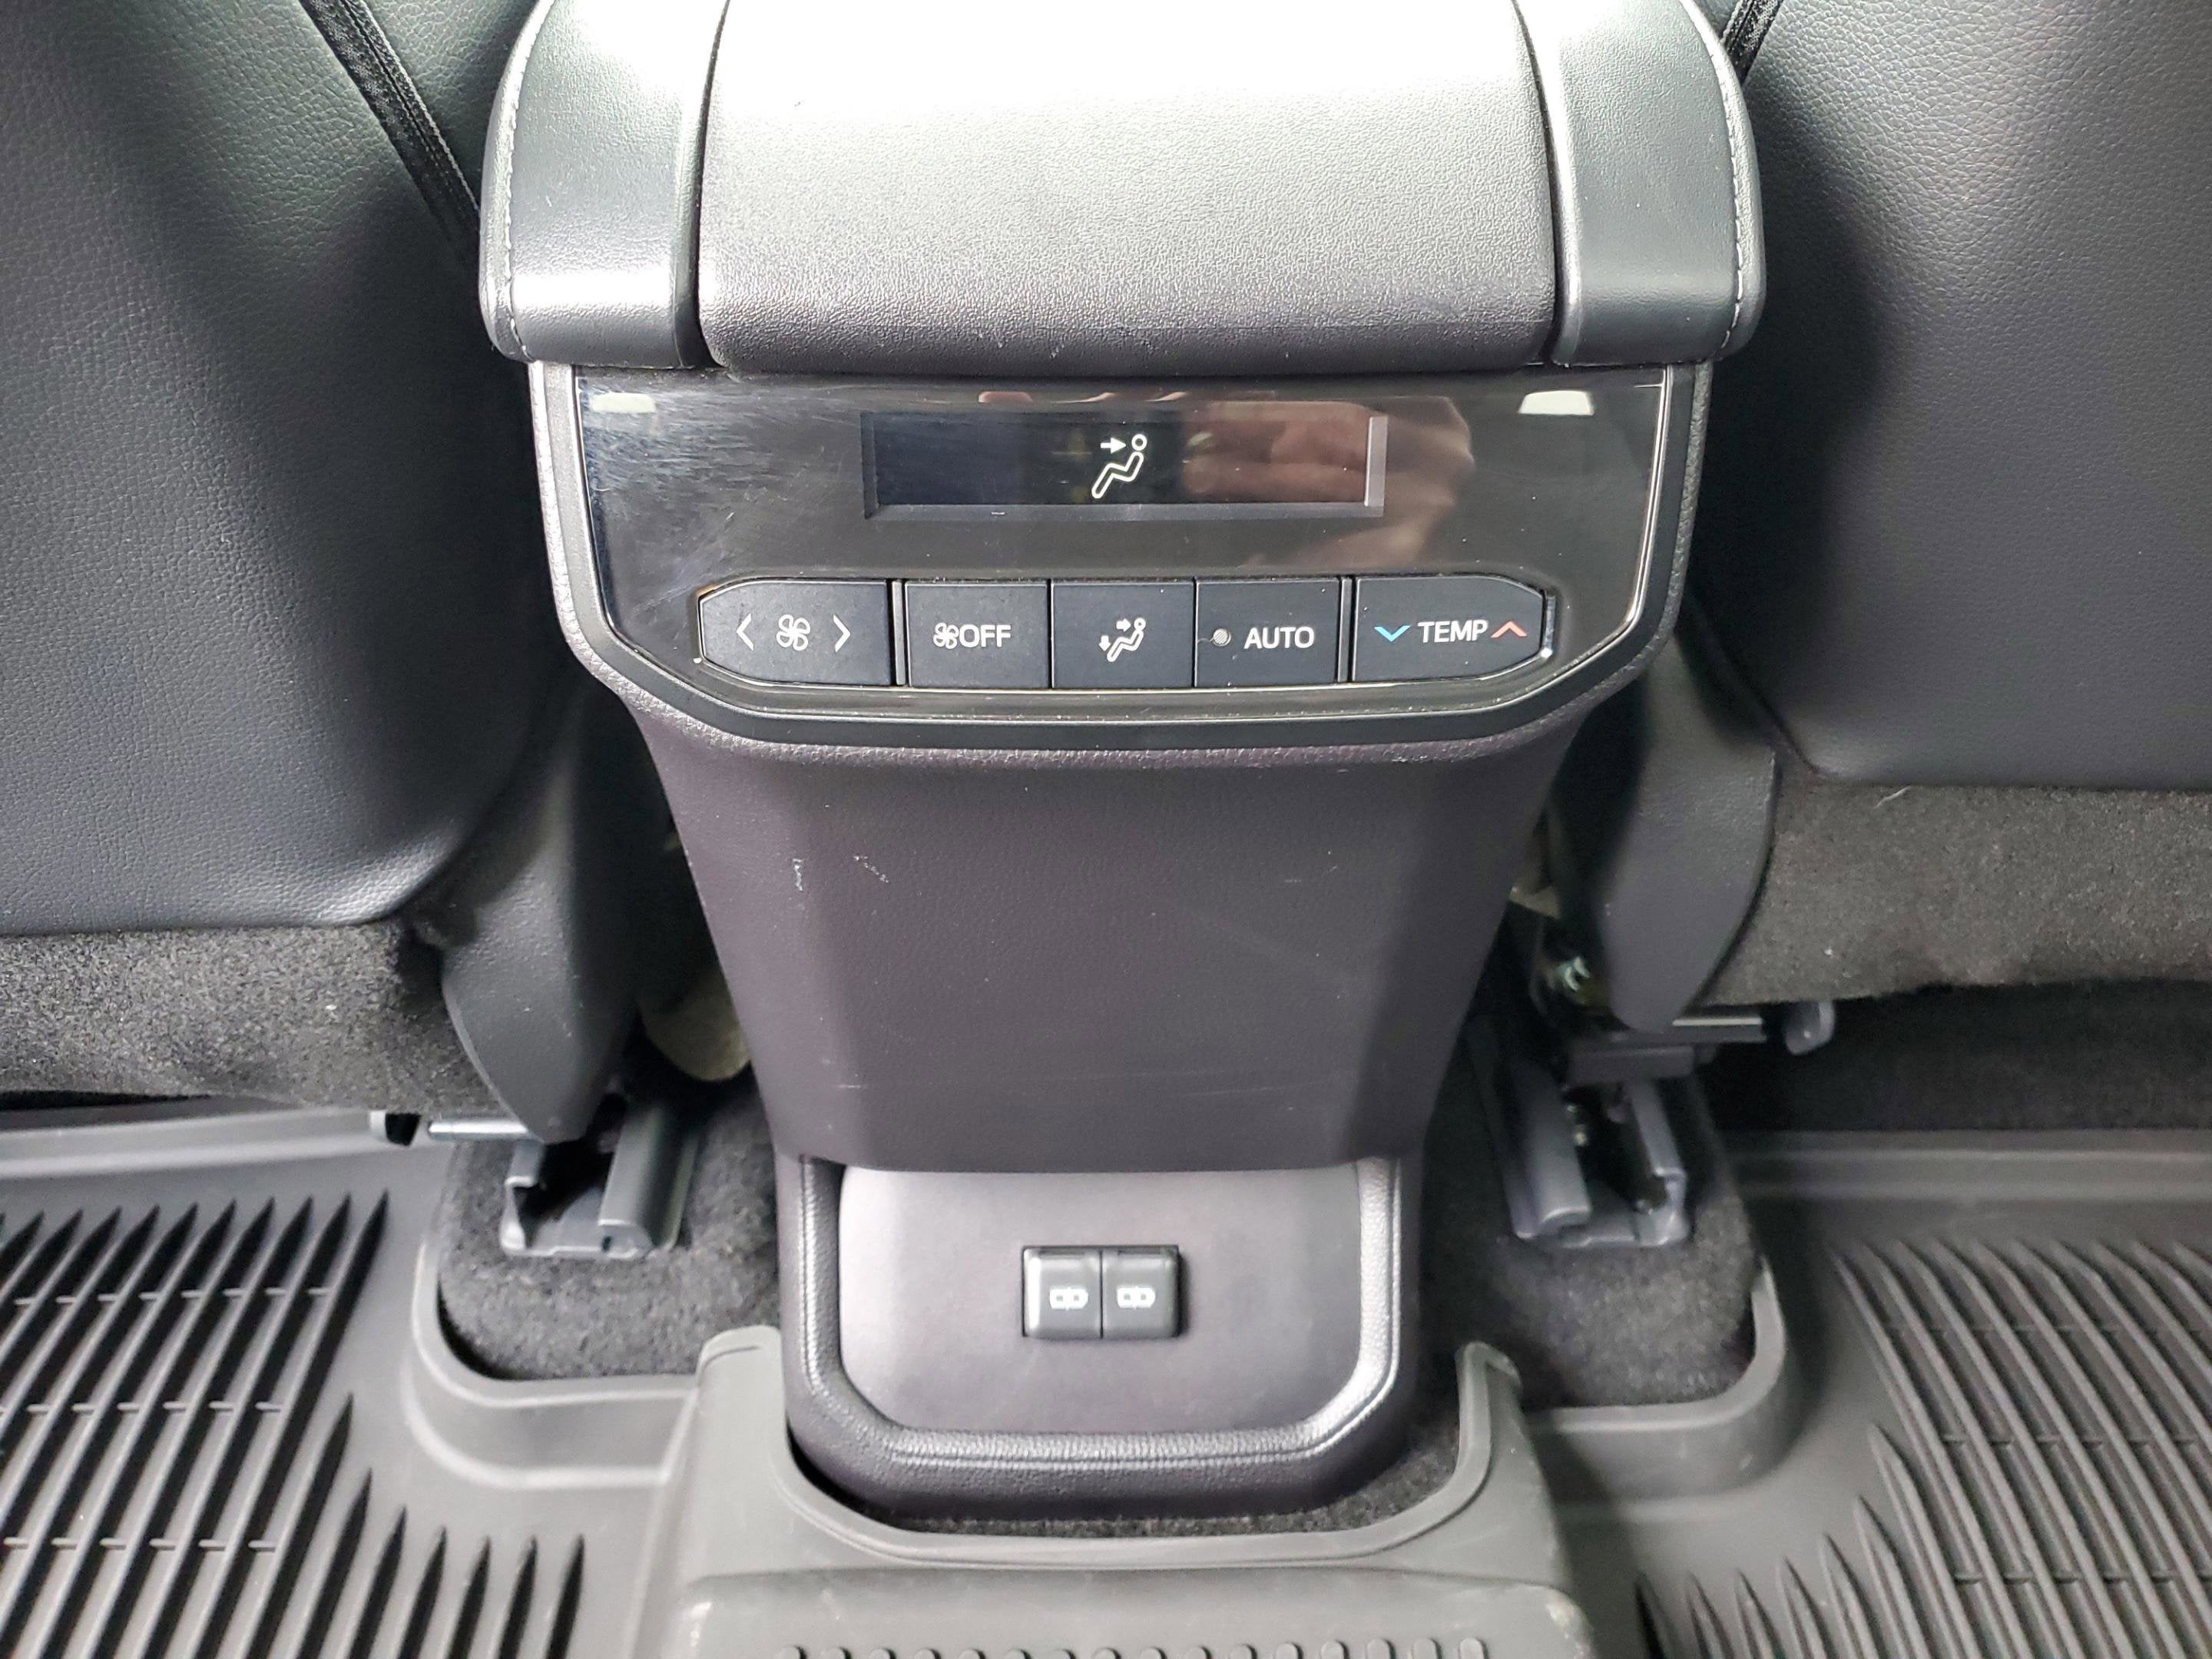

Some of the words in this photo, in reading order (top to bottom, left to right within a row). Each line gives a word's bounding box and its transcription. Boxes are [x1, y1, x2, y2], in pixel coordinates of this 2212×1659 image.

[959, 624, 1012, 648] OFF
[1243, 626, 1315, 649] AUTO
[1418, 620, 1488, 644] TEMP
